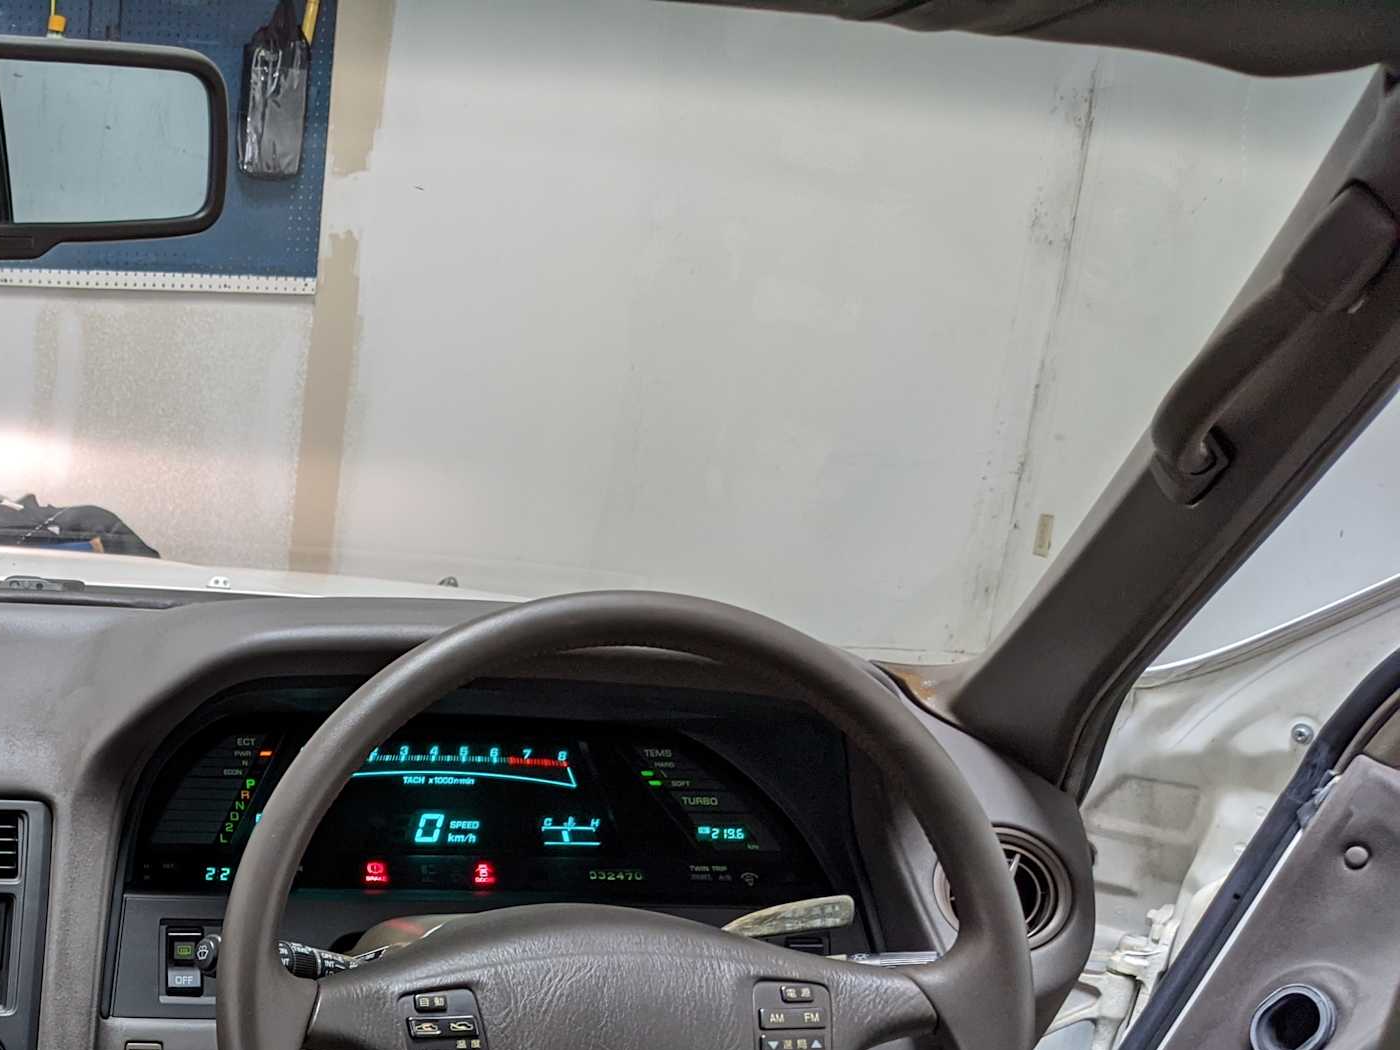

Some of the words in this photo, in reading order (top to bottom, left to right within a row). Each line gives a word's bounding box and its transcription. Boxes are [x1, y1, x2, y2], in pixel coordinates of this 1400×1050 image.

[236, 737, 256, 746] ECT
[400, 746, 409, 757] 3
[429, 746, 439, 757] 4
[459, 746, 468, 757] 5
[490, 748, 499, 758] 6
[523, 749, 532, 759] 7
[558, 751, 567, 761] 8
[643, 749, 672, 758] TEMS
[246, 779, 255, 789] P
[402, 776, 425, 785] TACH
[241, 790, 249, 799] R
[235, 801, 245, 810] N
[681, 796, 719, 806] TURBO
[230, 811, 239, 821] D
[225, 823, 233, 832] 2
[449, 820, 480, 830] SPEED
[543, 818, 553, 827] C
[590, 818, 600, 827] H
[414, 813, 445, 843] 0
[220, 833, 228, 843] L
[447, 833, 477, 843] km/h
[175, 976, 194, 985] OFF
[769, 1012, 785, 1023] AM
[803, 1012, 820, 1023] FM
